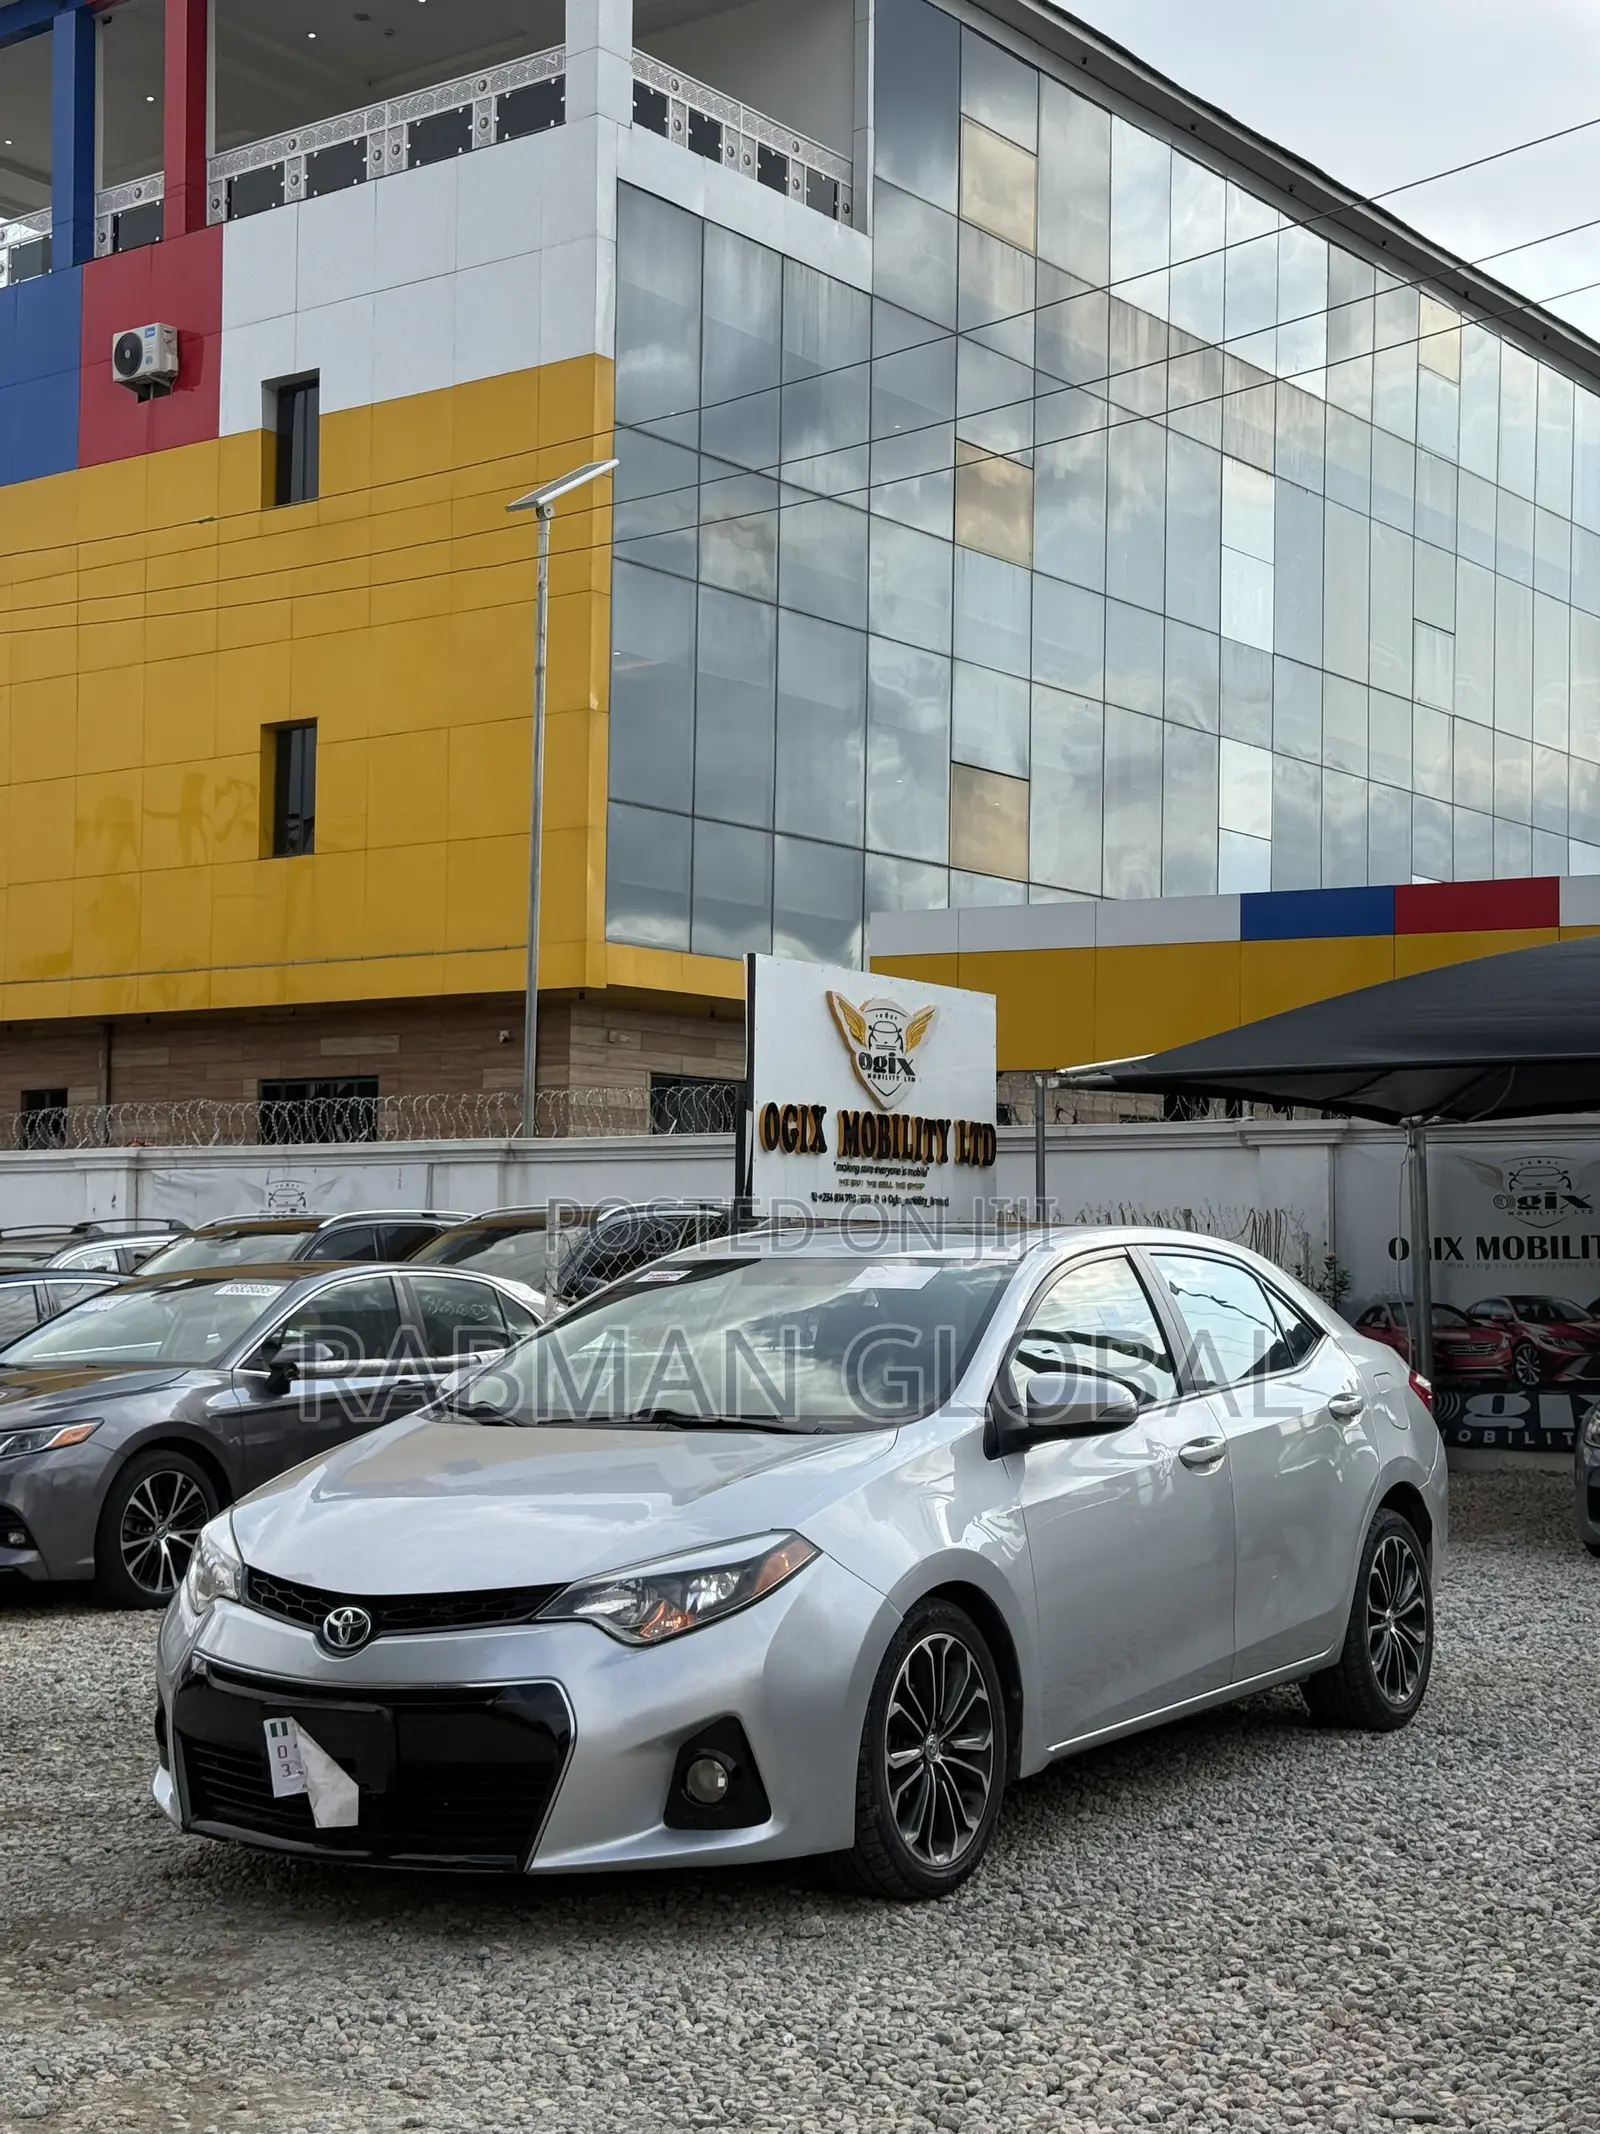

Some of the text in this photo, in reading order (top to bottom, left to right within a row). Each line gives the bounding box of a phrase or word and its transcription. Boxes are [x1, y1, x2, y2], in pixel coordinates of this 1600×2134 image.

[867, 1073, 900, 1081] MOBILITY
[759, 1102, 997, 1167] OGIX MOBILITY LTD
[1388, 1236, 1465, 1261] OIX
[1442, 1429, 1575, 1446] OBILIT
